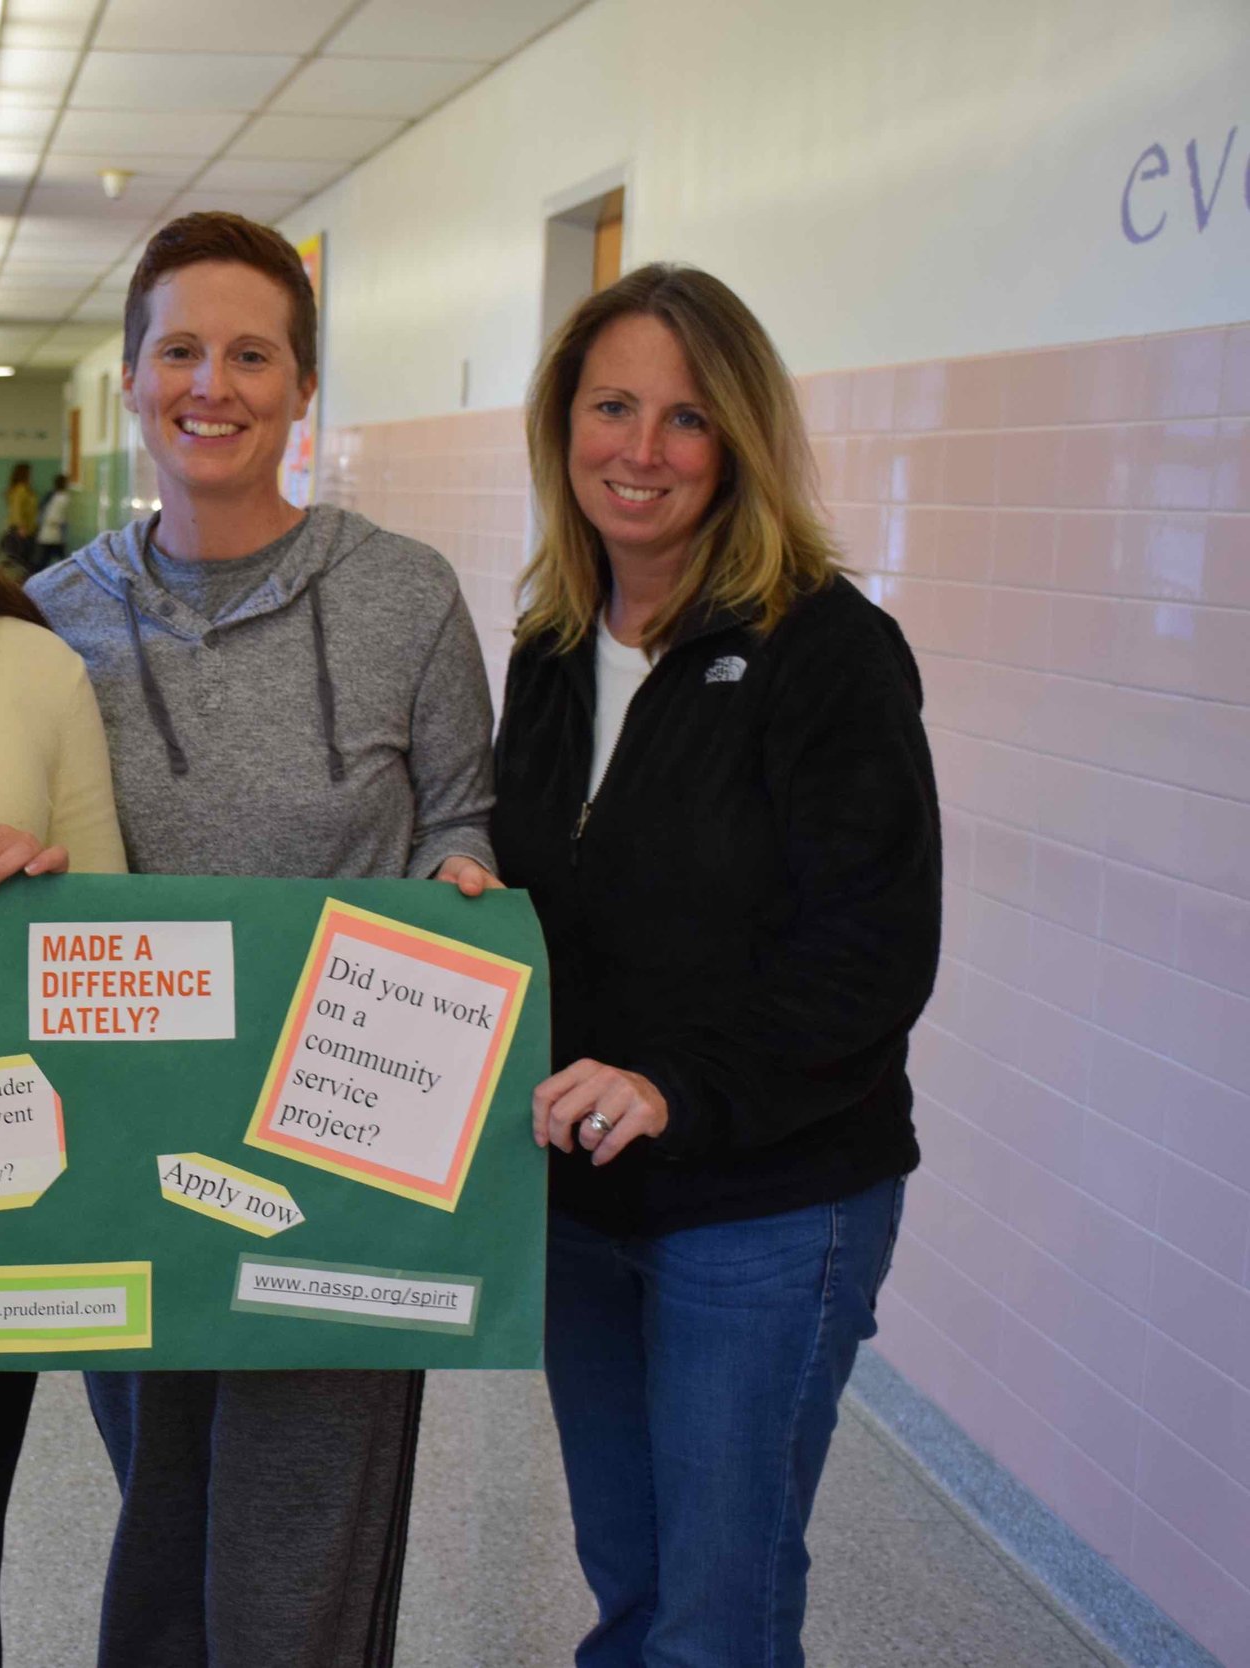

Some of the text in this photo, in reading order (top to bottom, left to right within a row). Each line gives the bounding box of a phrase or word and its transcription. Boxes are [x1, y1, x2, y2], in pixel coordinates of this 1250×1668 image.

[1121, 124, 1250, 244] ev
[42, 935, 153, 961] MADE A
[42, 970, 211, 998] DIFFERENCE
[326, 956, 494, 1029] Did you work
[42, 1006, 160, 1034] LATELY?
[316, 998, 366, 1027] on a
[304, 1033, 442, 1094] community
[292, 1068, 379, 1108] service
[279, 1103, 381, 1147] project?
[162, 1161, 300, 1225] Apply now
[254, 1273, 458, 1308] www.nassp.org/spirit
